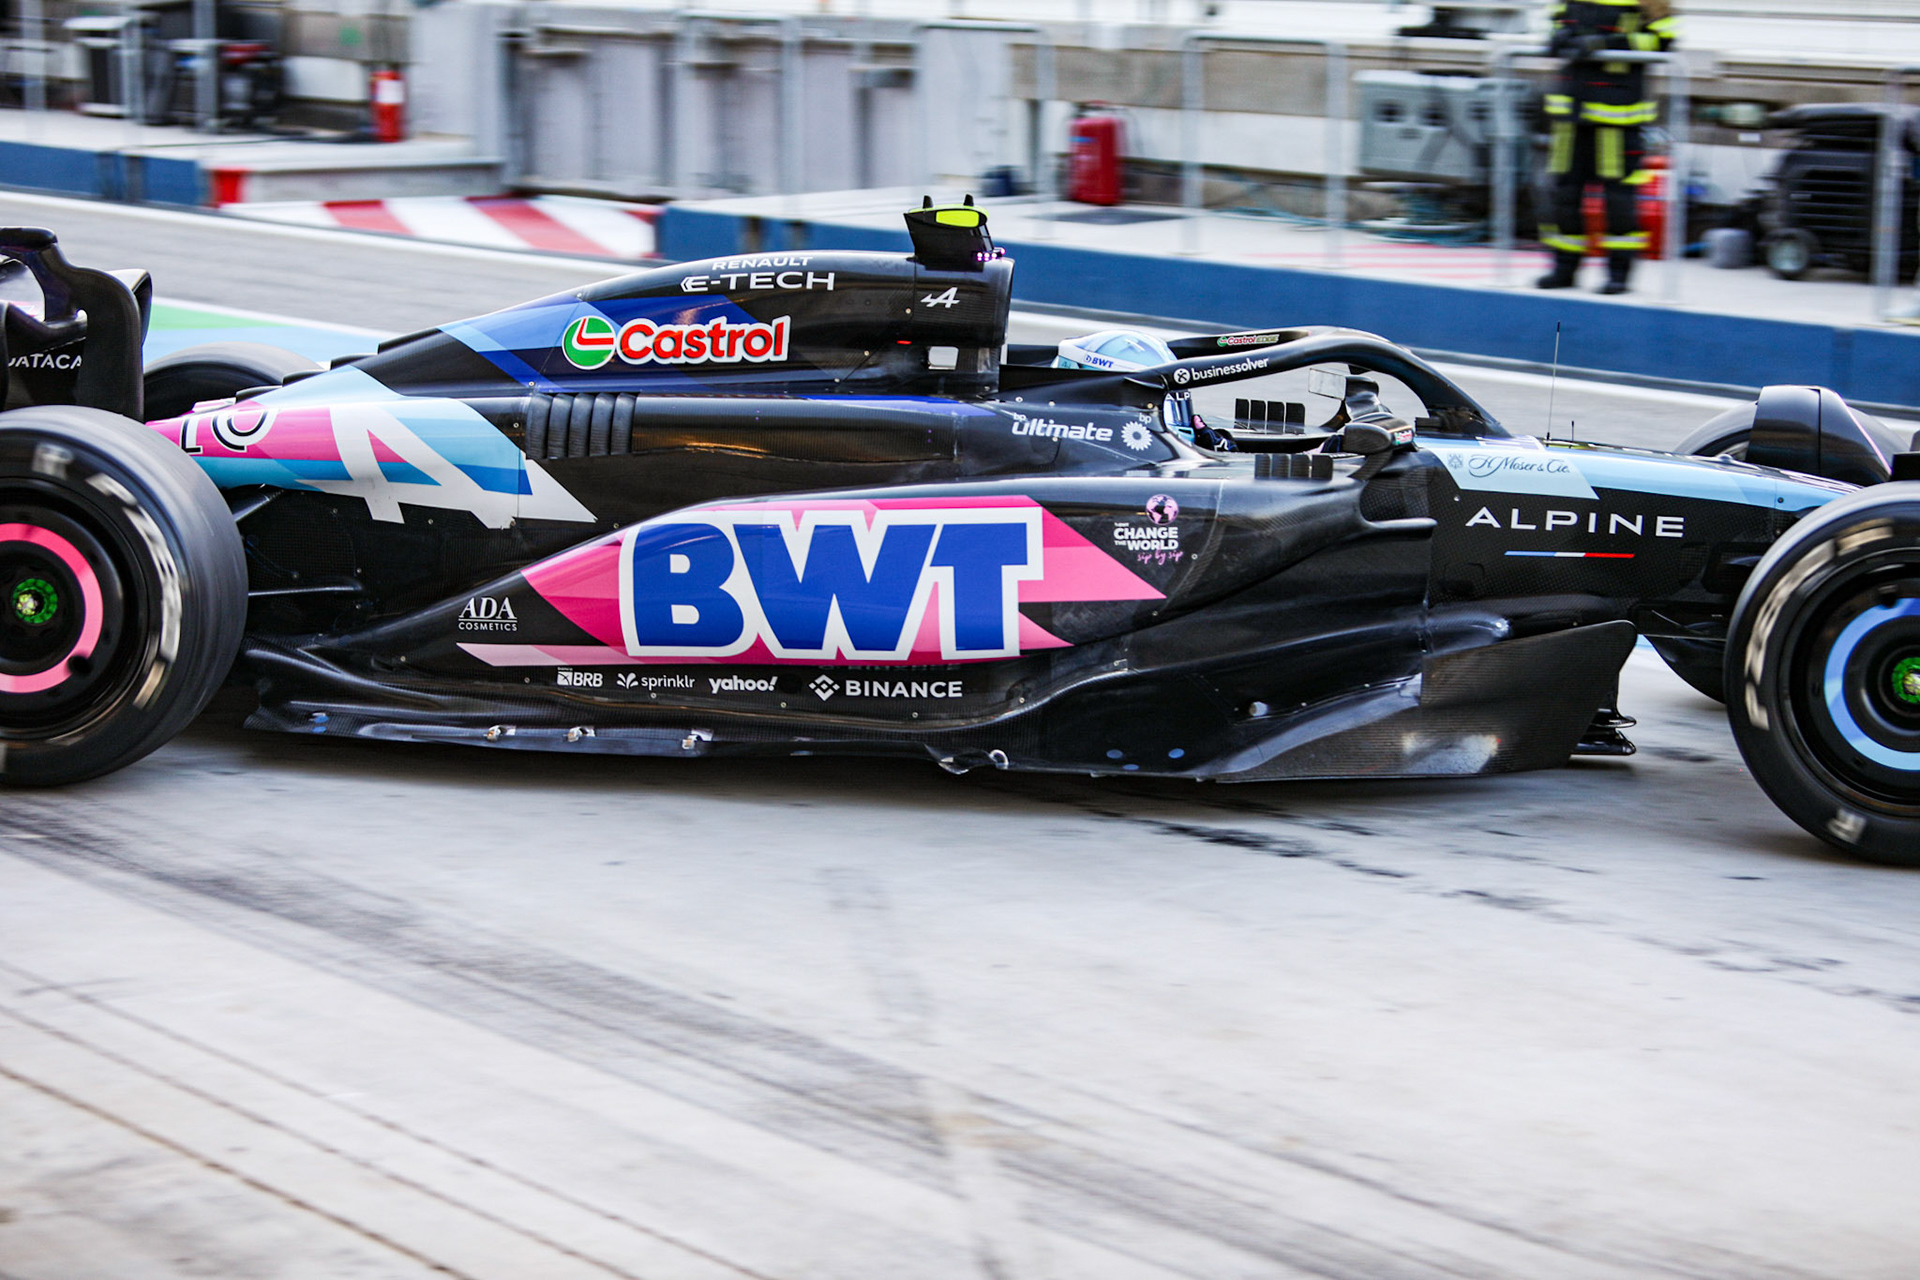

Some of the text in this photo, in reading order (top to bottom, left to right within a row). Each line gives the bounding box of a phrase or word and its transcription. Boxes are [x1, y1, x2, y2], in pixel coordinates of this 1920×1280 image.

[712, 256, 814, 271] RENAULT
[680, 271, 835, 293] E-TECH
[618, 315, 790, 364] Castrol
[1227, 335, 1255, 346] Castrol
[8, 353, 83, 370] ATACA
[1091, 357, 1114, 369] BWT
[1191, 357, 1269, 382] businessolver
[1138, 413, 1152, 425] bp
[1011, 418, 1113, 442] ultimate
[1537, 463, 1544, 472] &
[1465, 506, 1686, 538] ALPINE
[1113, 526, 1179, 540] CHANGE
[1127, 539, 1179, 551] WORLD
[1137, 547, 1184, 566] sip by sip
[621, 510, 1041, 659] BWT
[458, 596, 518, 620] ADA
[458, 621, 518, 632] COSMETICS
[572, 671, 604, 688] BRB
[640, 674, 695, 691] sprinklr
[708, 676, 779, 695] yahoo!
[845, 679, 964, 699] BINANCE
